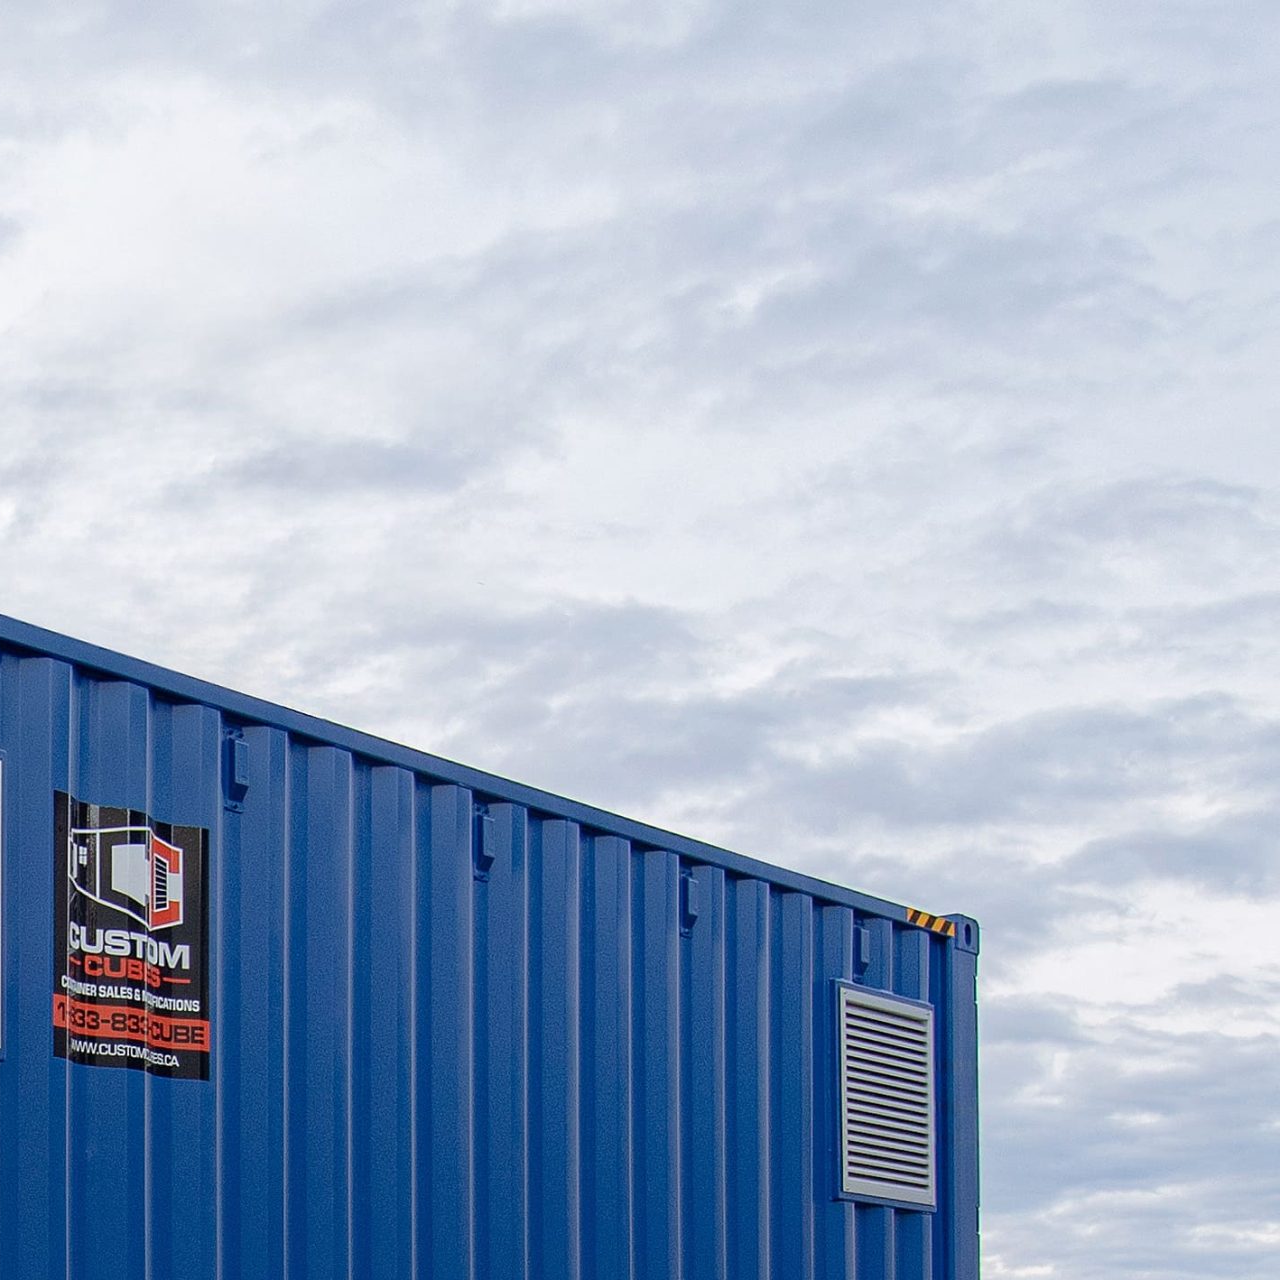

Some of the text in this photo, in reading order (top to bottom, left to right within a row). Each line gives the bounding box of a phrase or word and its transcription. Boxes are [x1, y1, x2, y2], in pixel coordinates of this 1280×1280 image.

[69, 921, 190, 970] CUSTOM
[98, 985, 133, 1000] SALES
[134, 988, 141, 1001] &
